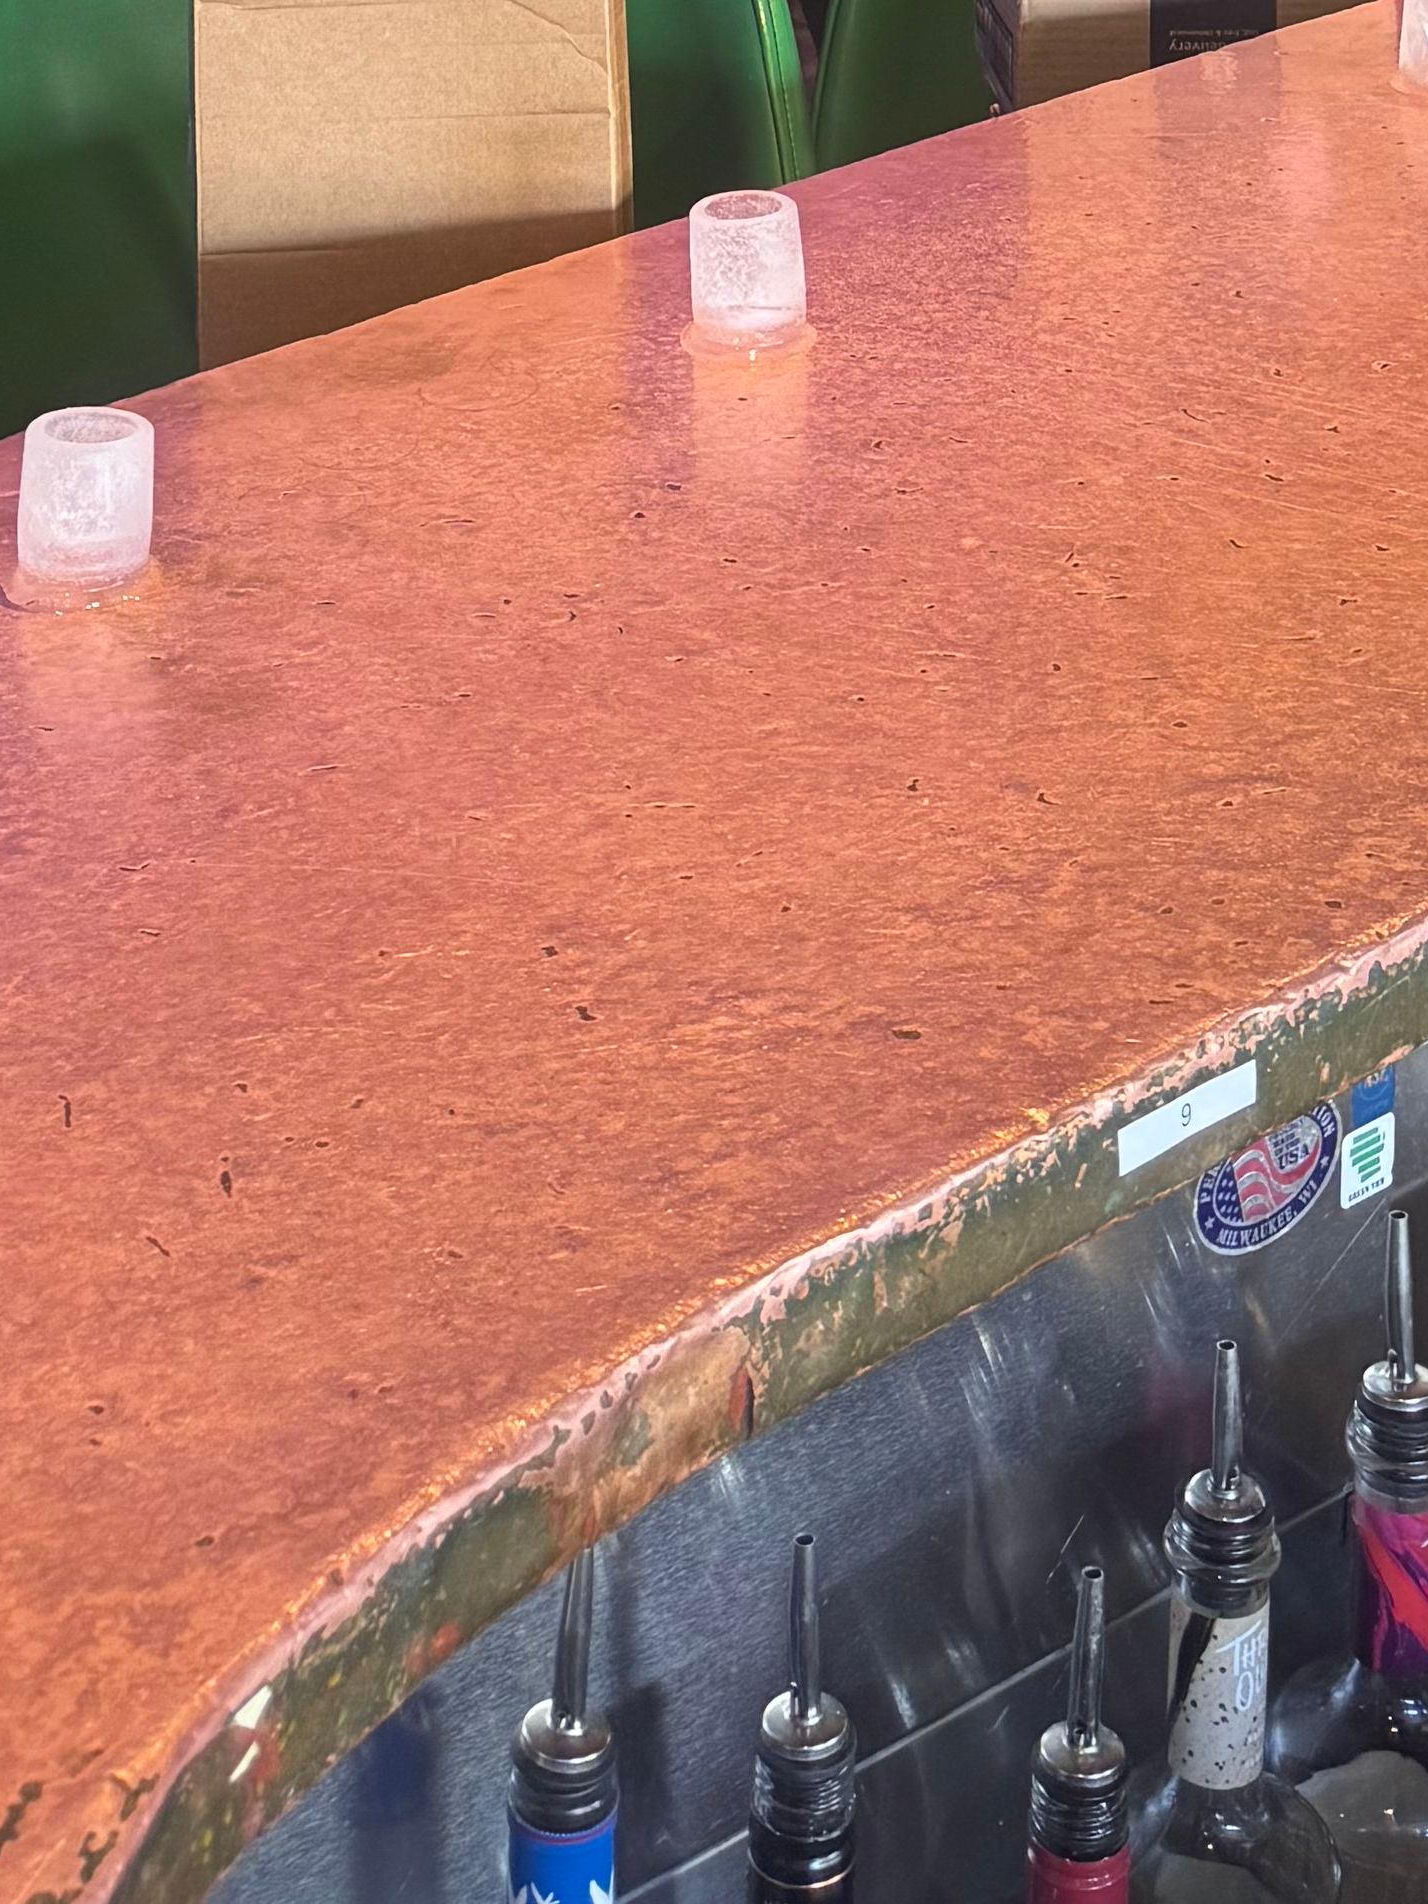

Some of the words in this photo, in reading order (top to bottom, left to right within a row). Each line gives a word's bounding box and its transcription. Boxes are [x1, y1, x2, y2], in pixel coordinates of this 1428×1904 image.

[1180, 1103, 1192, 1127] 9
[1277, 1145, 1311, 1170] USA
[1216, 1208, 1298, 1246] MILWAUKEE,
[1300, 1180, 1320, 1205] WI
